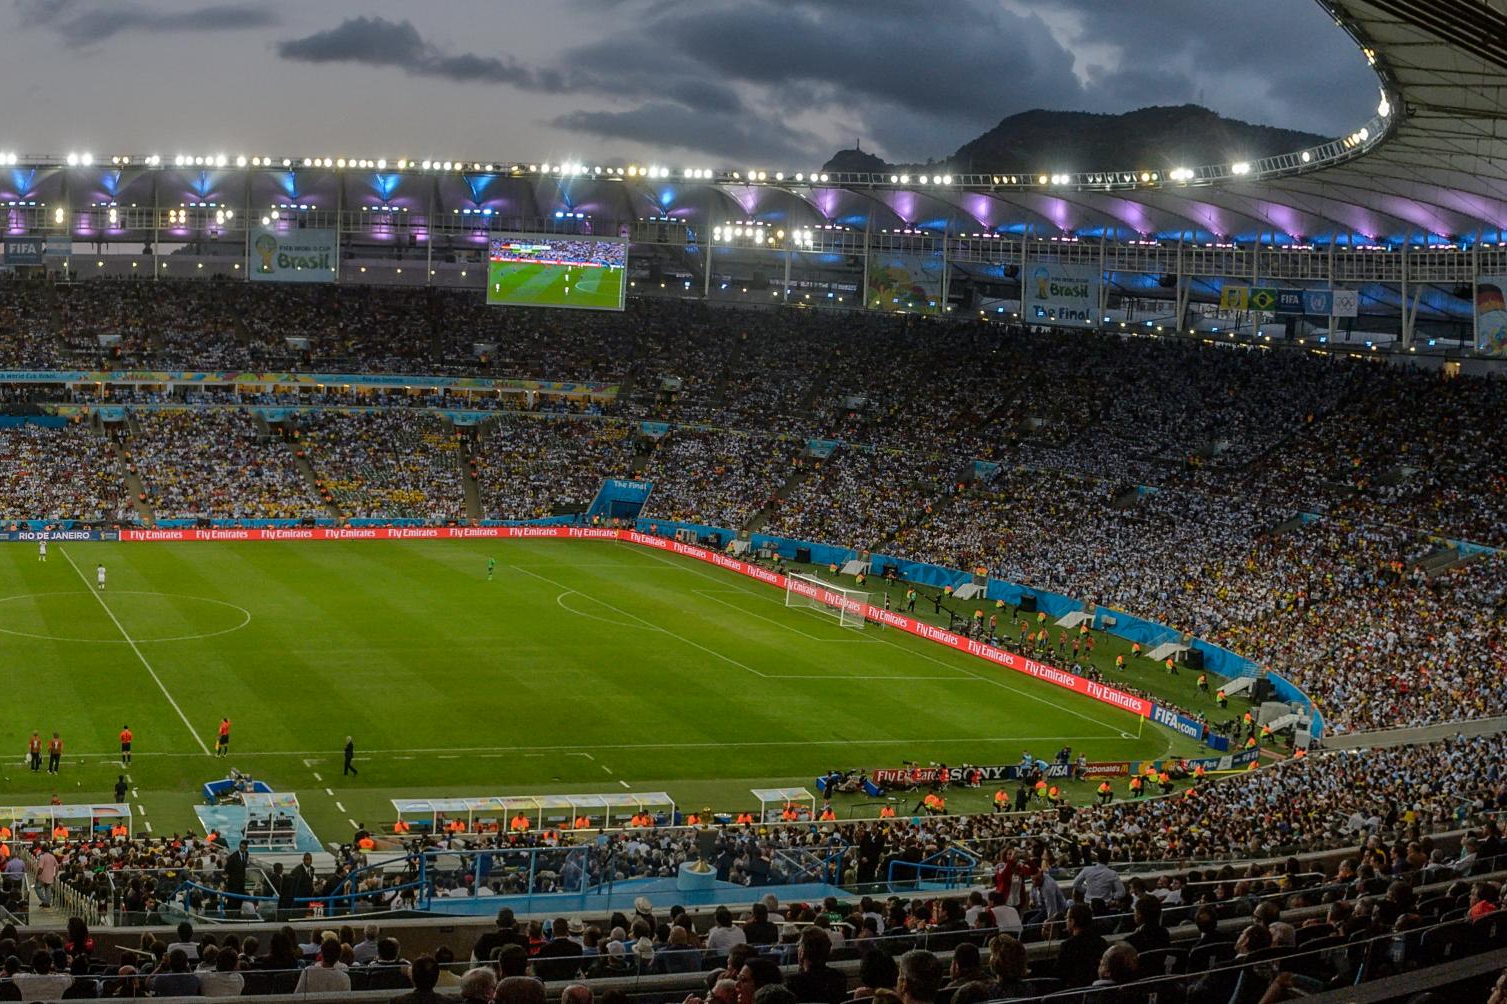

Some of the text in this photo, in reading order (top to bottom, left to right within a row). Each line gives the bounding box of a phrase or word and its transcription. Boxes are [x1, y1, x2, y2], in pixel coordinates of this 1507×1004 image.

[9, 243, 36, 253] FIFA
[278, 252, 329, 269] Brasil
[1050, 283, 1089, 298] Brasil
[1280, 294, 1299, 304] FIFA
[1033, 304, 1090, 321] The Final
[614, 480, 647, 490] The Final
[19, 532, 90, 540] RIO DE JANEIRO
[130, 531, 144, 540] Fly
[196, 530, 248, 540] Fly Emirates
[261, 530, 275, 539] Fly
[325, 529, 376, 539] Fly Emirates
[388, 529, 401, 538] Fly
[449, 529, 462, 538] Fly
[509, 528, 522, 537] Fly
[569, 528, 582, 537] Fly
[631, 532, 666, 547] Fly Emirates
[674, 542, 706, 558] Fly Emirates
[712, 553, 741, 570] Fly Emirates
[747, 565, 777, 583] Fly Emirates
[793, 581, 817, 597] Emirates
[824, 592, 835, 605] Fly
[868, 606, 907, 628] Fly Emirates
[916, 622, 958, 645] Fly Emirates
[967, 640, 1014, 666] Fly Emirates
[1025, 660, 1075, 687] Fly Emirates
[1086, 681, 1142, 711] Fly Emirates
[1154, 706, 1197, 737] FIFA.com
[877, 770, 939, 782] Fly Eate
